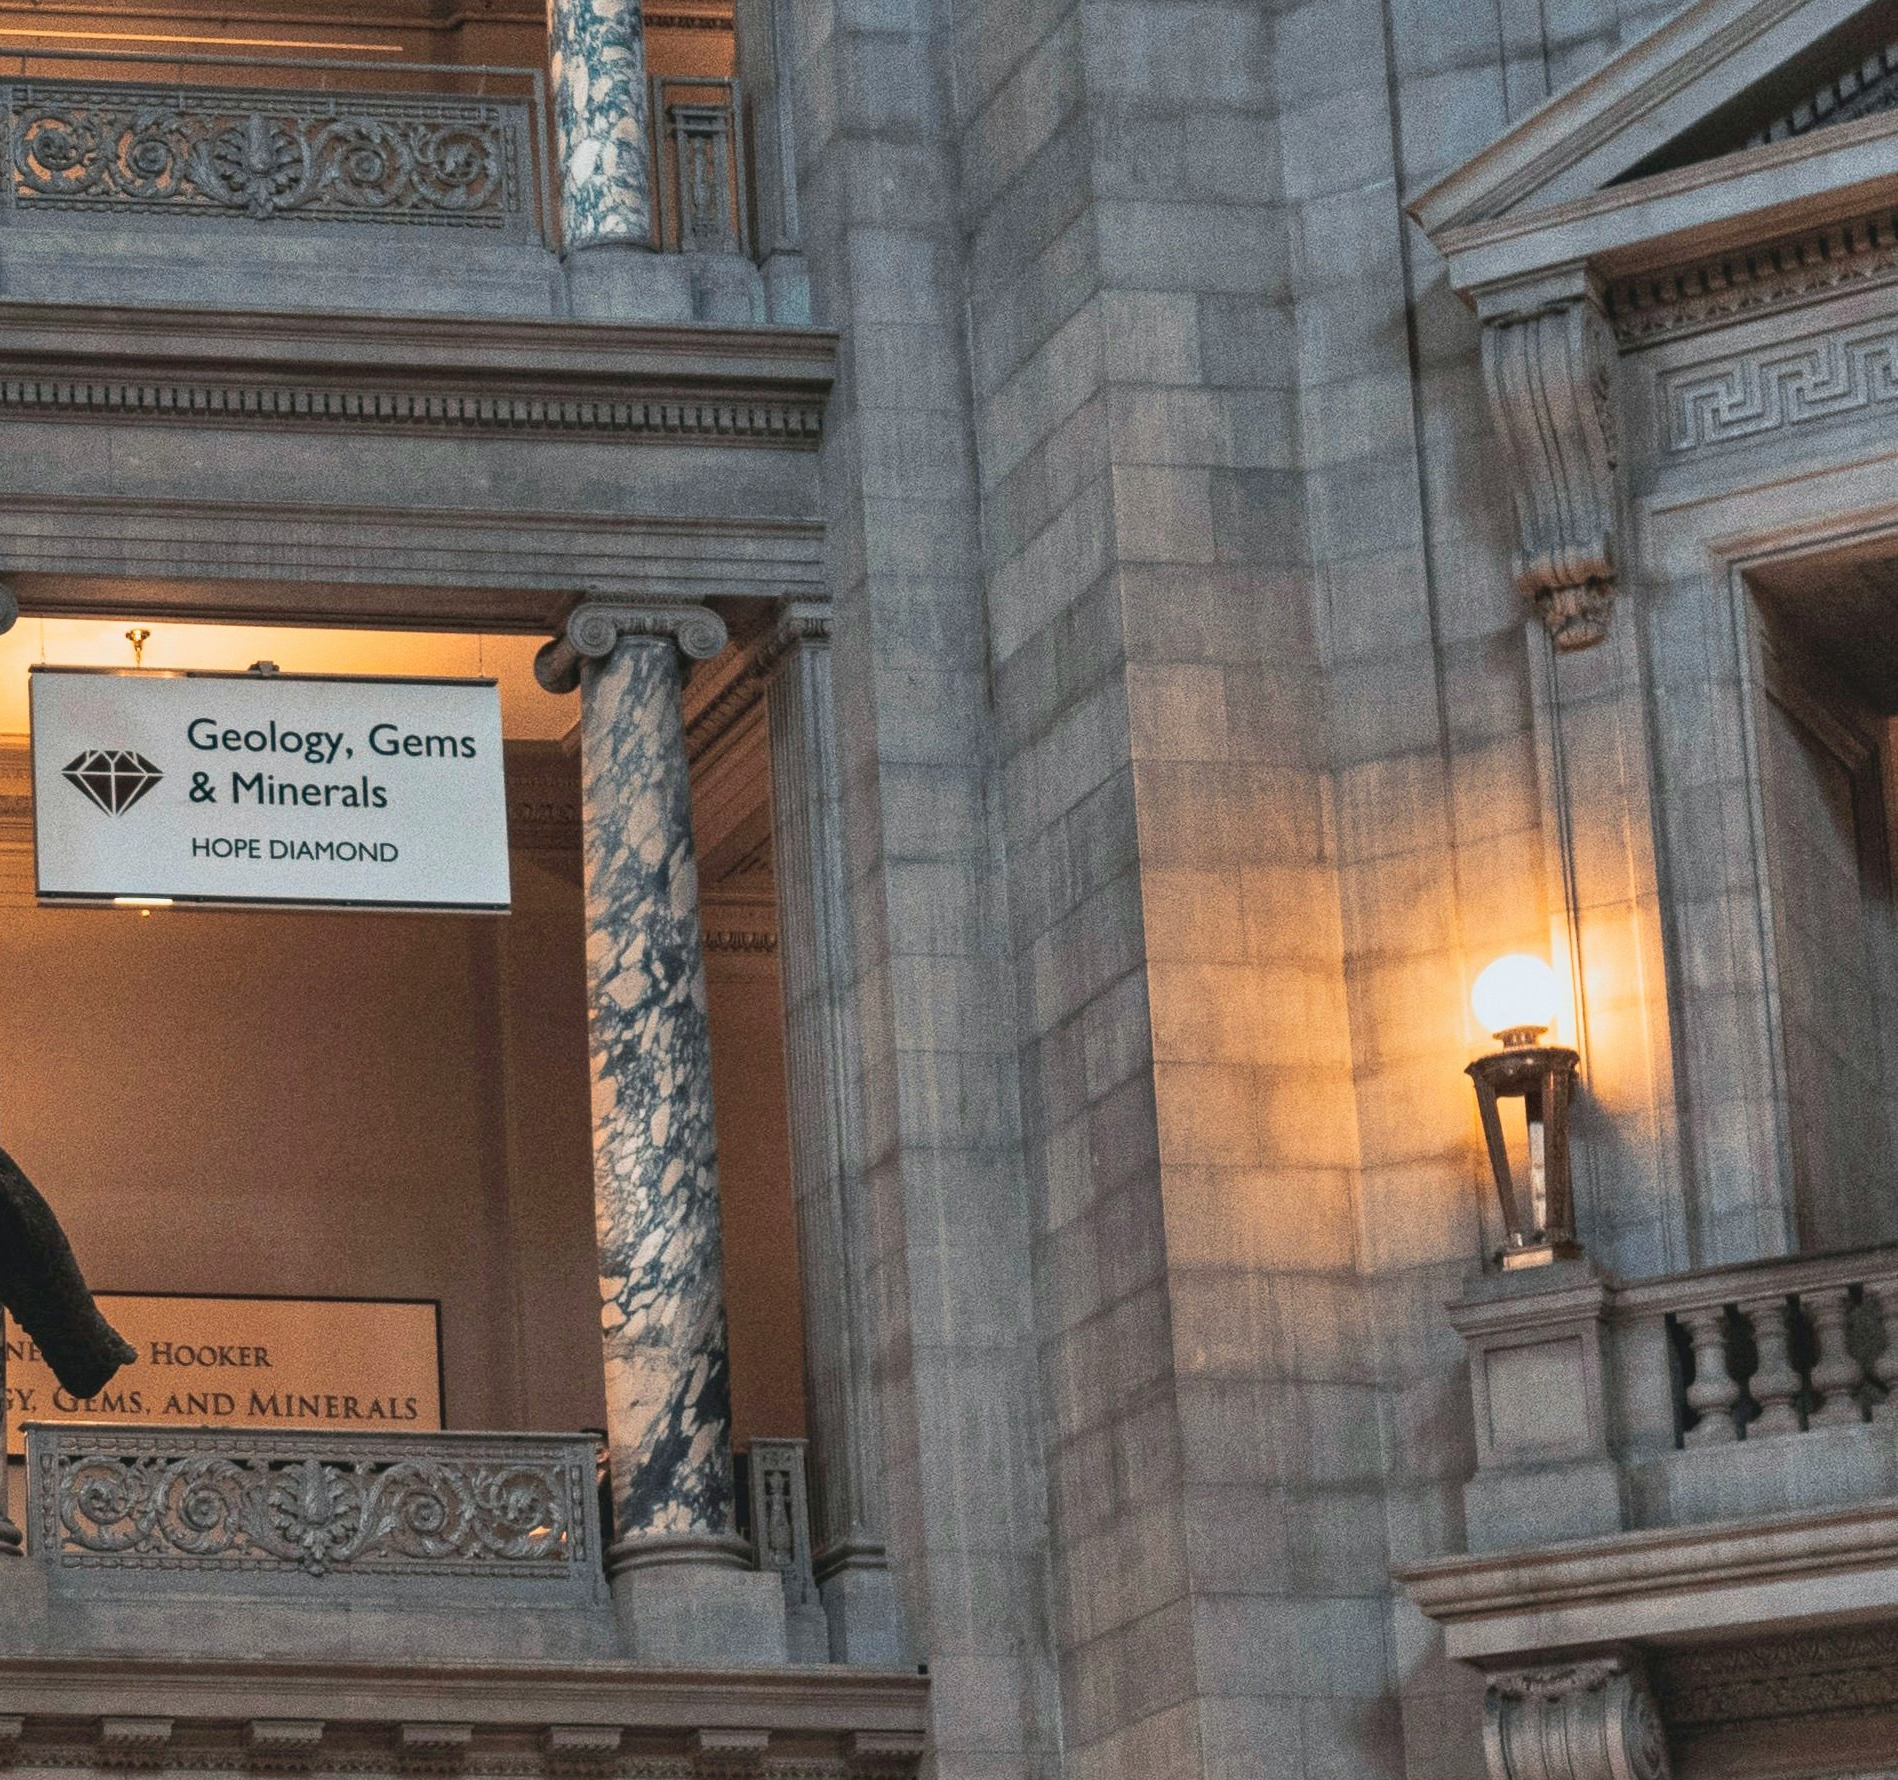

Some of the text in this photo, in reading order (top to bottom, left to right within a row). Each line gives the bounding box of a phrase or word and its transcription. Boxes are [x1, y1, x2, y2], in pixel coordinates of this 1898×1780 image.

[187, 718, 476, 764] Geology, Gems
[189, 773, 388, 808] & Minerals
[192, 838, 398, 862] HOPE DIAMOND
[151, 1341, 273, 1368] HOOKER
[162, 1392, 235, 1416] AND
[248, 1390, 418, 1421] MINERALS
